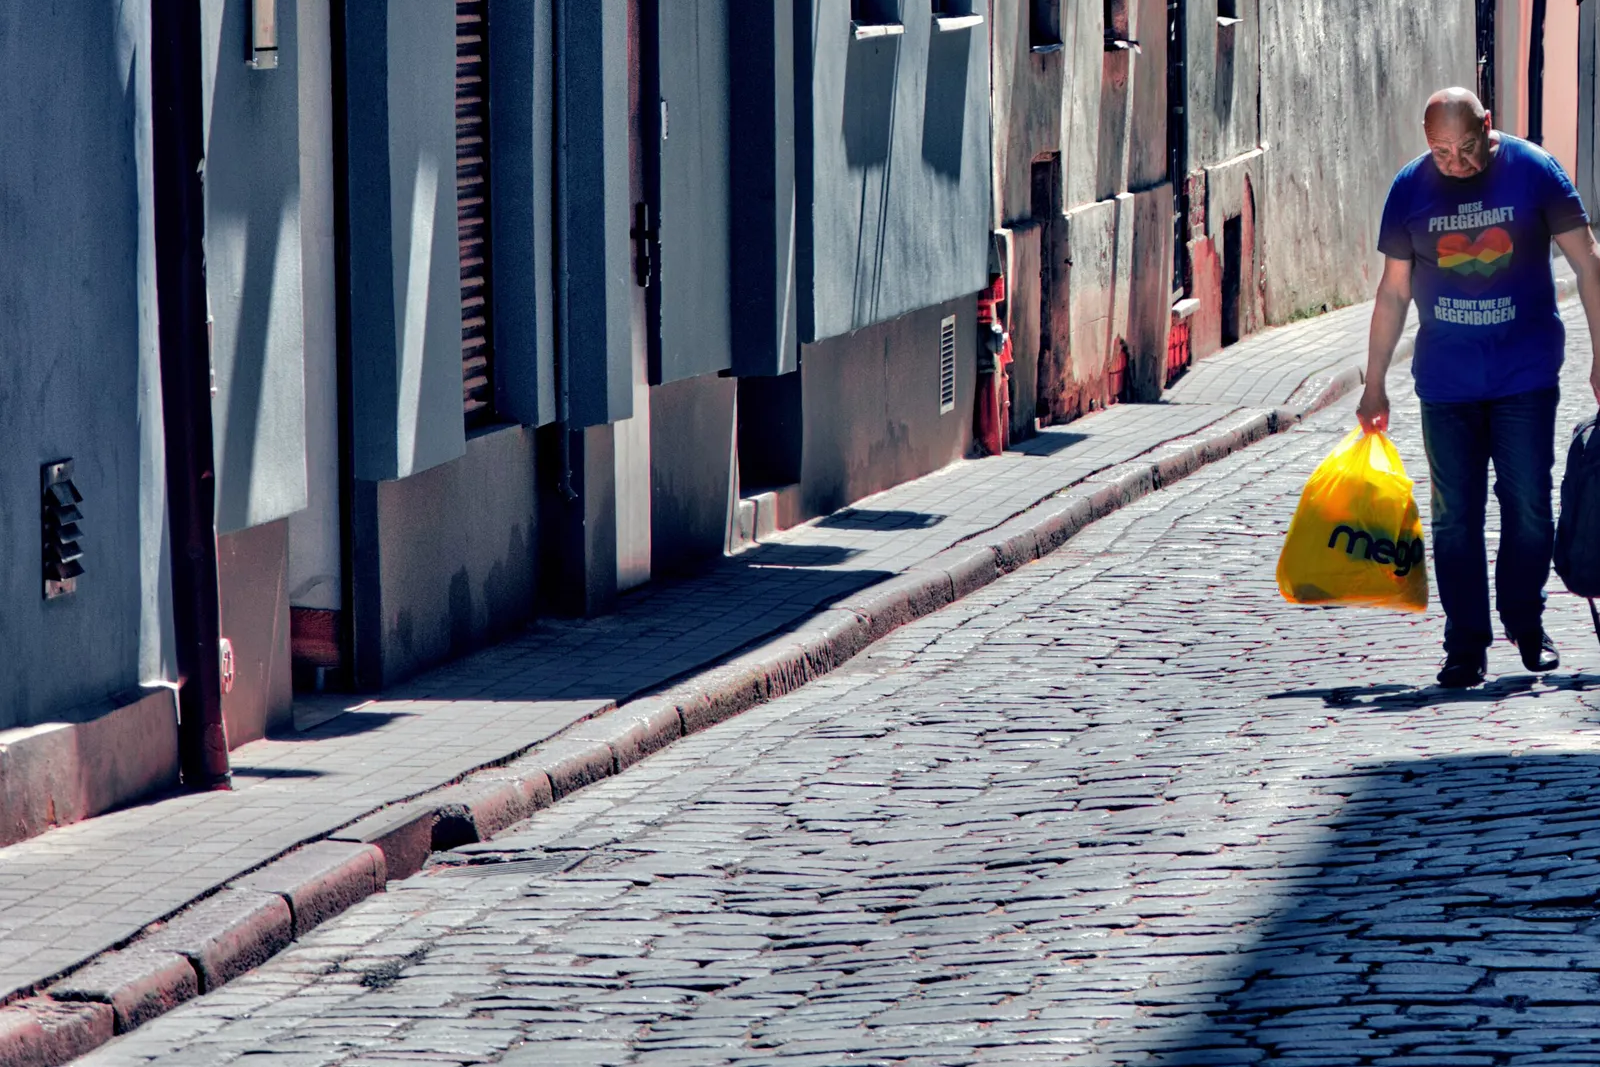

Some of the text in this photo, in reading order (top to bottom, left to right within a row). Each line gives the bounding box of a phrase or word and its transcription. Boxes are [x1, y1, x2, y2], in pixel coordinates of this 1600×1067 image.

[1458, 201, 1483, 214] DIESE
[1428, 206, 1515, 232] PFLEGEKRAFT
[1438, 296, 1512, 310] IST BUNT WIE EIN
[1434, 305, 1516, 325] REGENBOGEN
